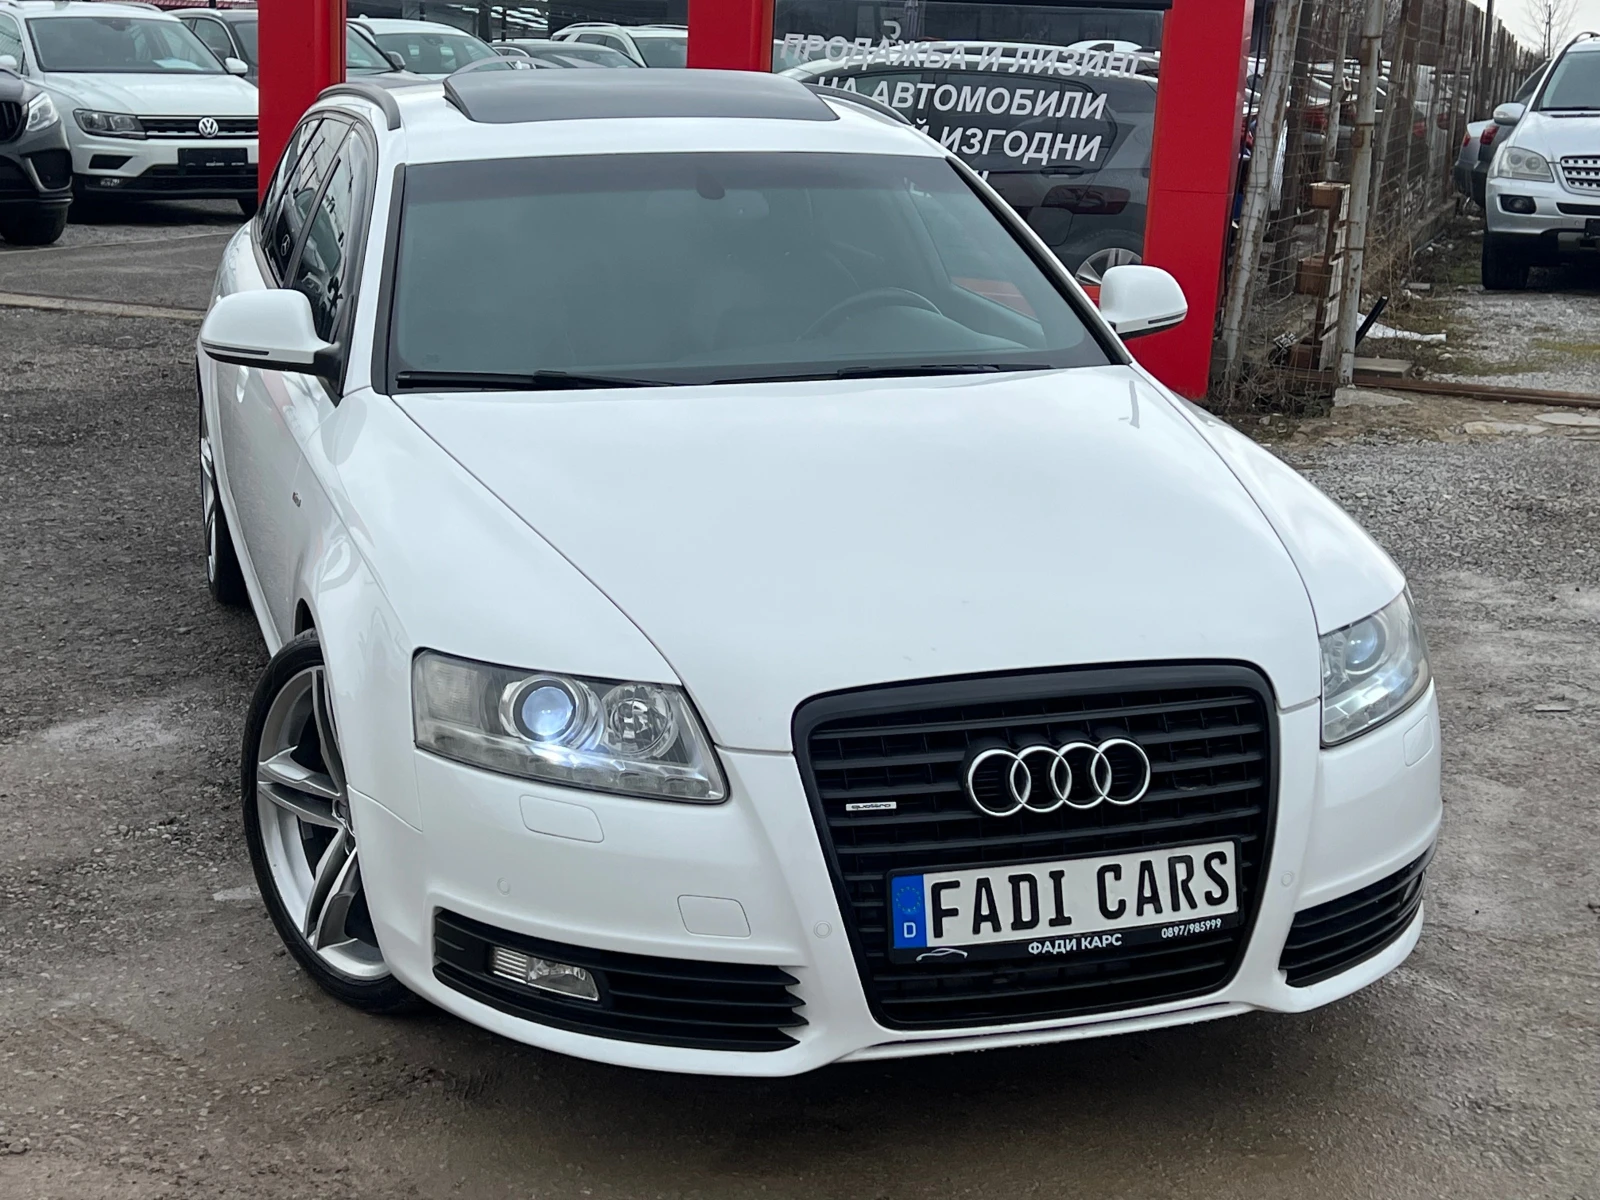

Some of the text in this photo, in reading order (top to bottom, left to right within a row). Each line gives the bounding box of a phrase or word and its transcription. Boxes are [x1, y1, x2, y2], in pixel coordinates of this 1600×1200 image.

[780, 33, 967, 70] ПРОДАЖБА
[977, 45, 1003, 72] И
[871, 80, 1107, 119] АВТОМОБИЛИ
[940, 126, 1102, 165] ИЗГОДНИ
[903, 851, 1229, 938] D FADI CARS
[1028, 933, 1123, 955] ФАДИ КАРС
[1161, 918, 1222, 939] 0897/985999
